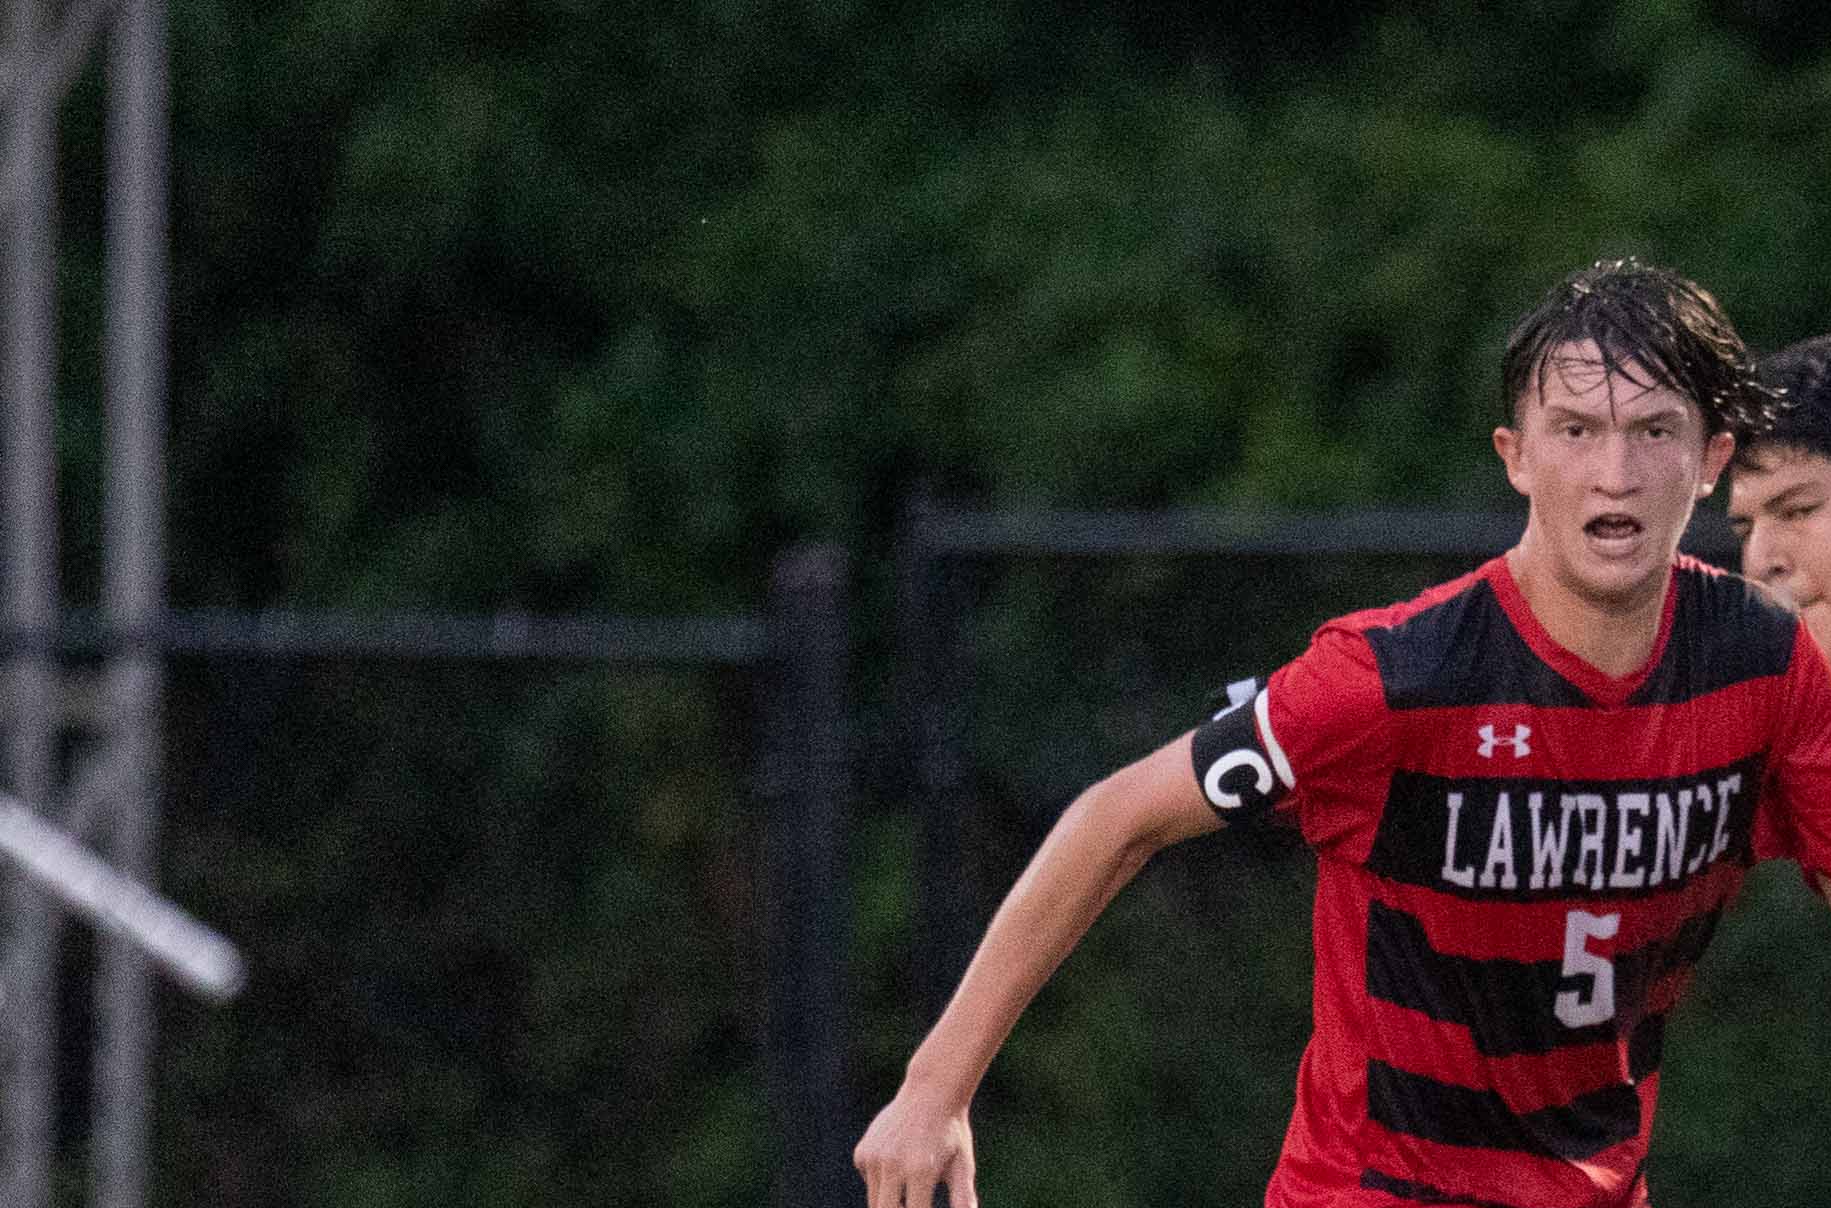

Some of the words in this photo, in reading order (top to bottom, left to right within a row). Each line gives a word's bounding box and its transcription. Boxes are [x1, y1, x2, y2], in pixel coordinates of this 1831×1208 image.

[1204, 748, 1273, 809] C
[1441, 773, 1742, 890] LAWRENCE
[1554, 909, 1622, 1029] 5
